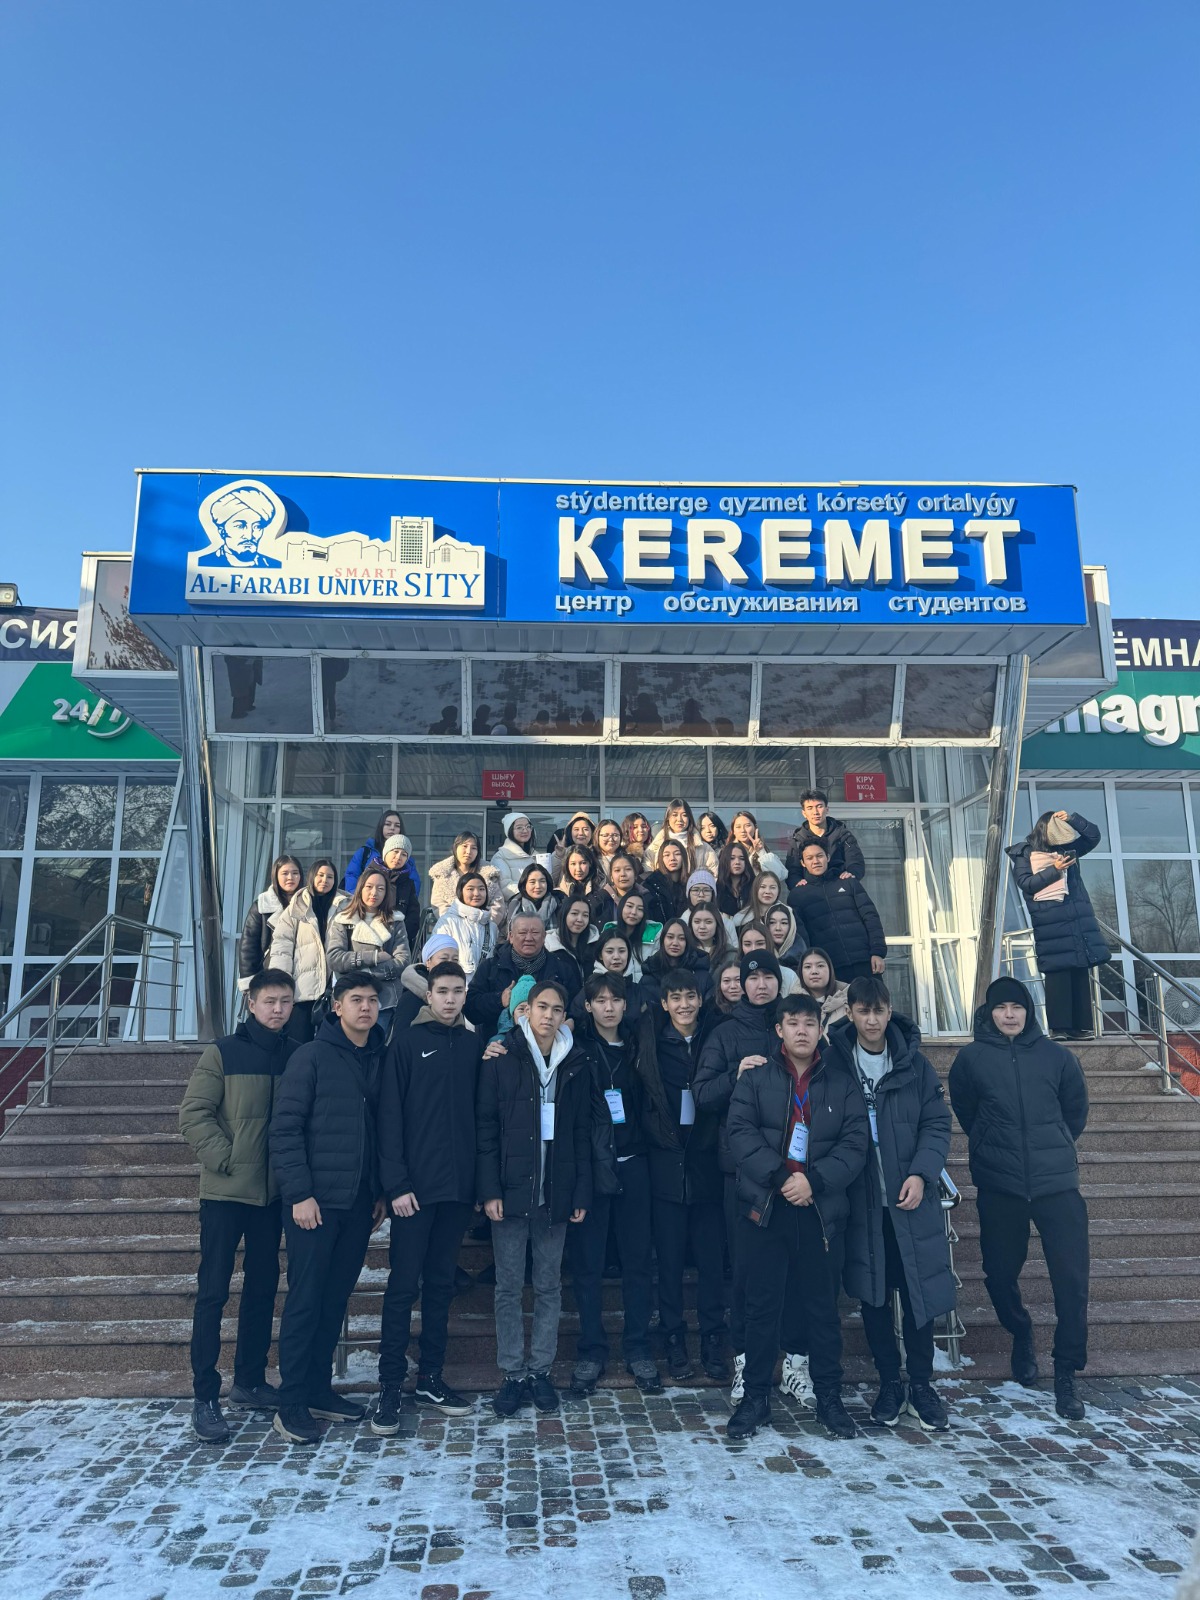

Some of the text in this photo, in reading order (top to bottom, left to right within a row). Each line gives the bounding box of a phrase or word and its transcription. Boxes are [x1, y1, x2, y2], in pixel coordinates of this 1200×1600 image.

[556, 490, 709, 516] stýdentterge
[719, 493, 808, 517] qyzmet
[817, 492, 907, 516] kórsetý
[558, 517, 1021, 585] KEREMET
[189, 573, 310, 595] AL-FARABI
[334, 567, 397, 578] SMART
[555, 592, 1028, 617] центр обслуживания студентов
